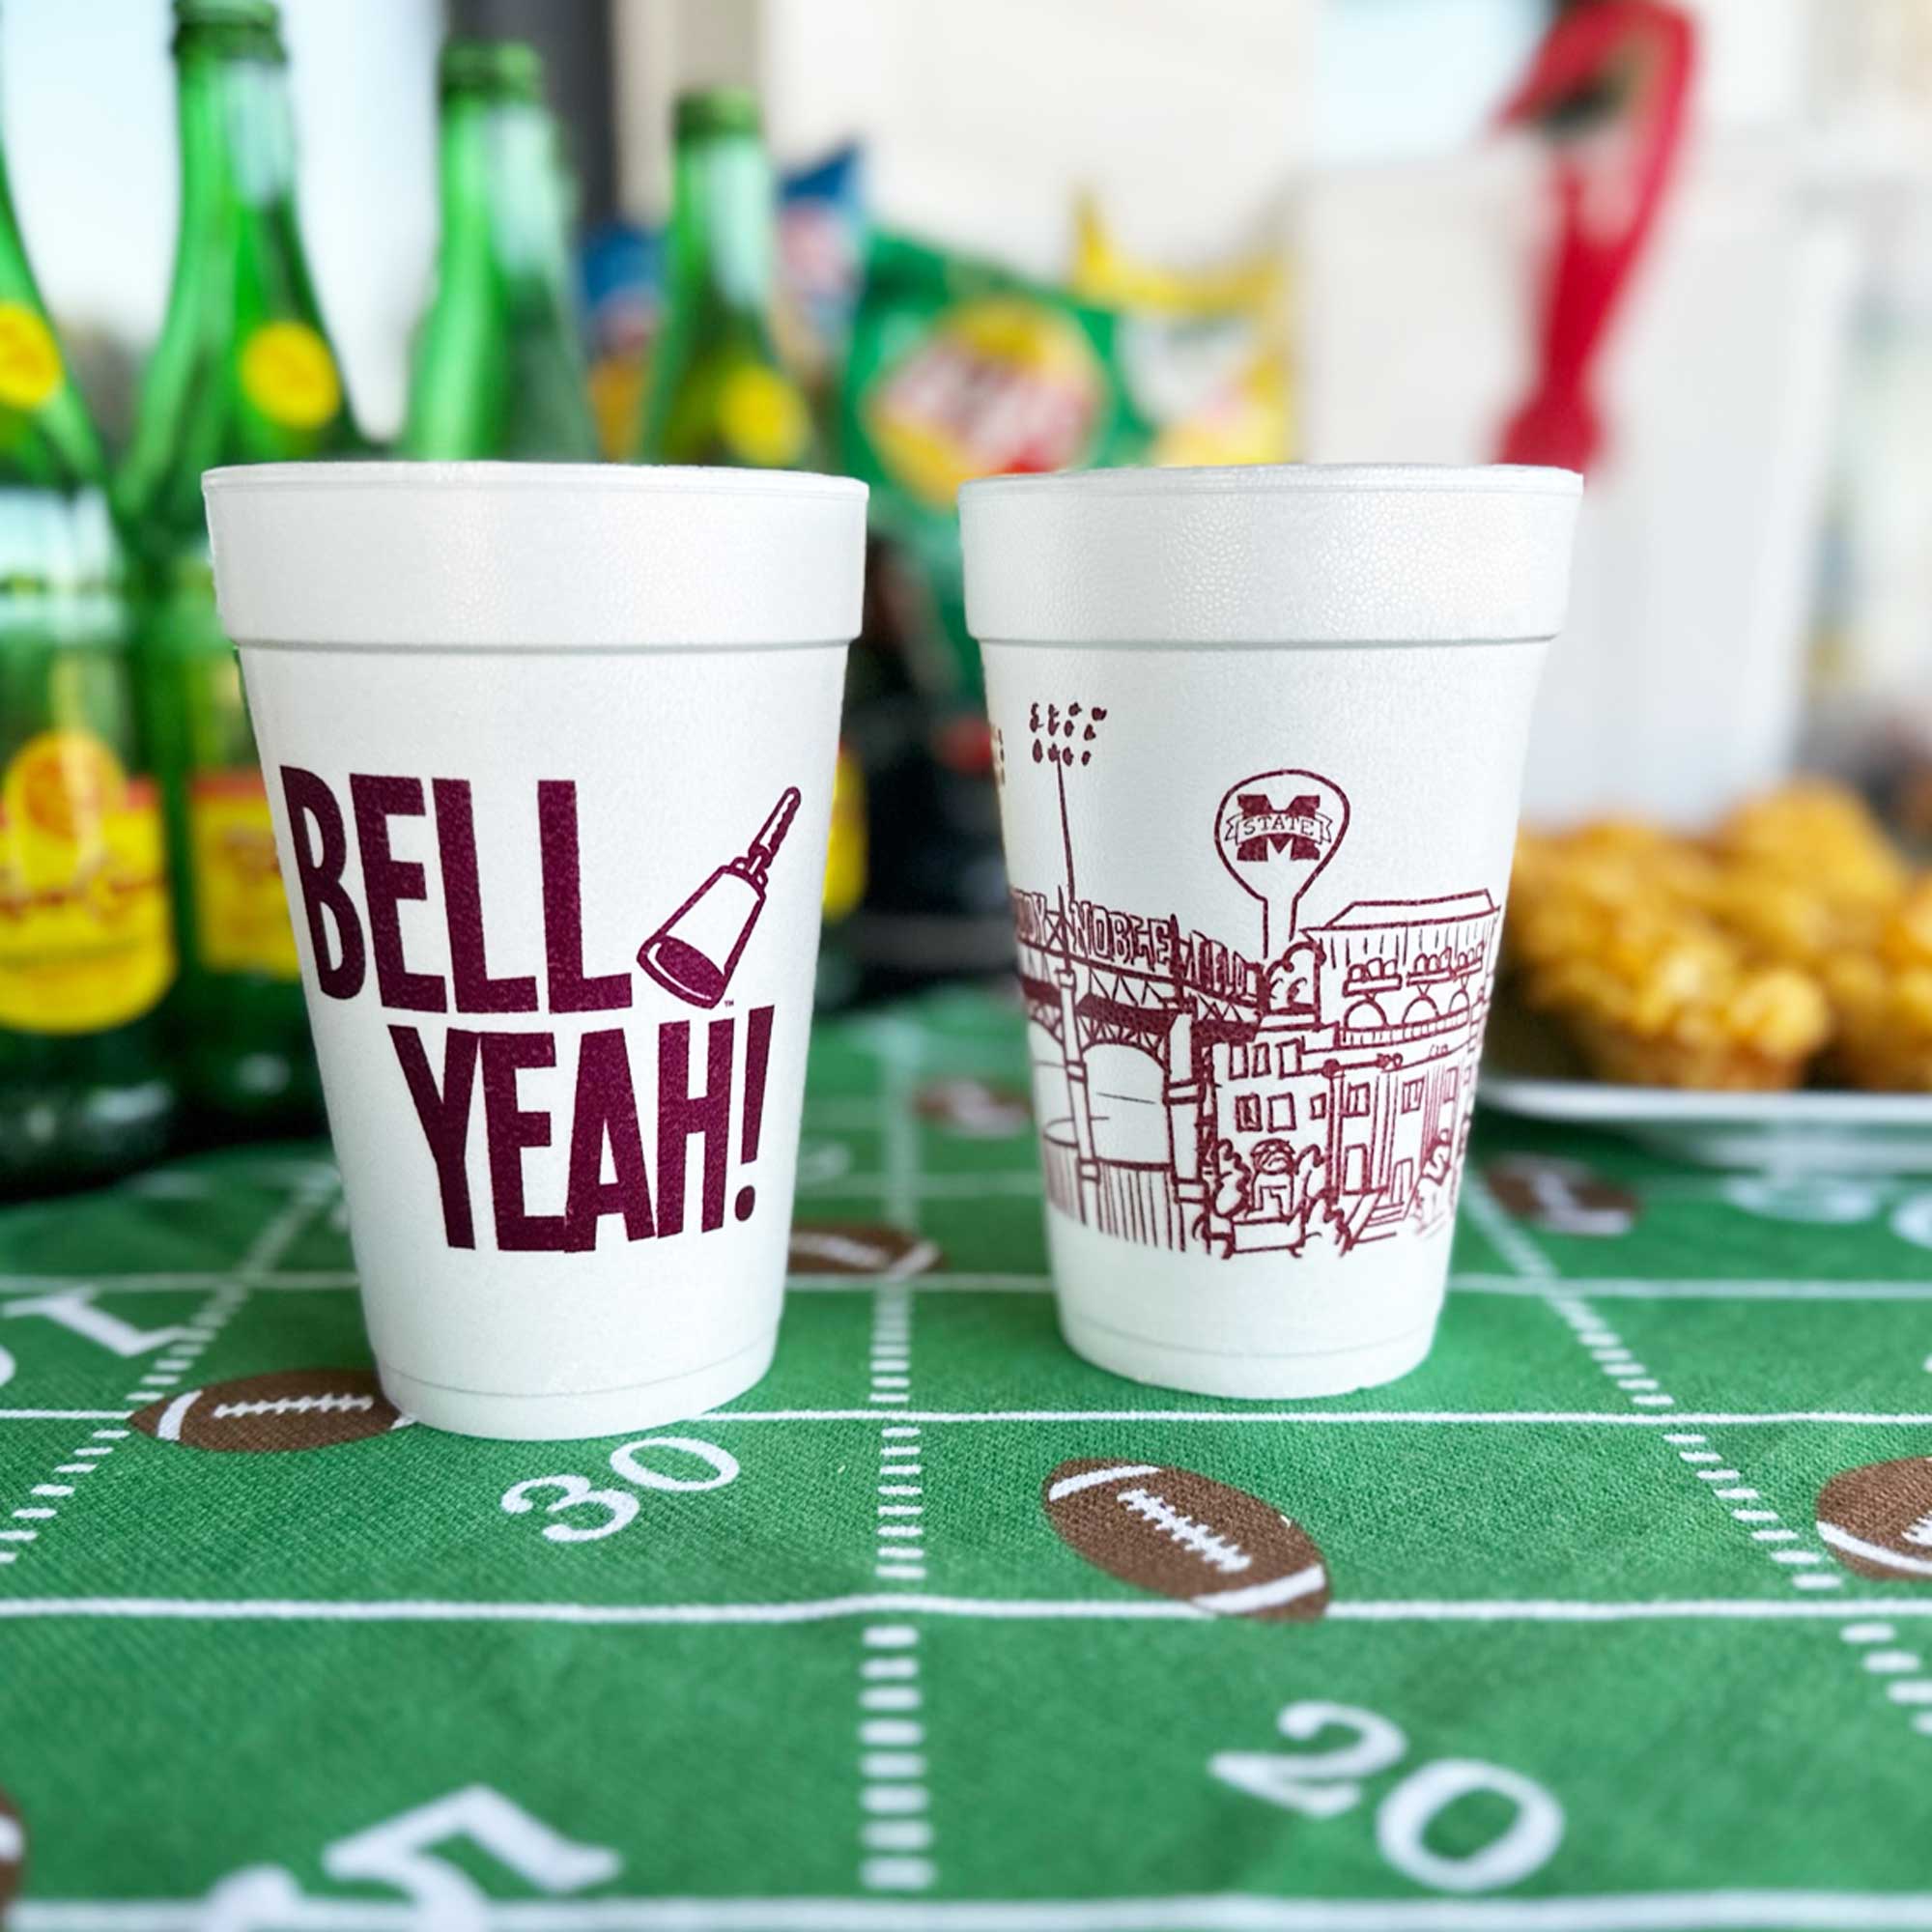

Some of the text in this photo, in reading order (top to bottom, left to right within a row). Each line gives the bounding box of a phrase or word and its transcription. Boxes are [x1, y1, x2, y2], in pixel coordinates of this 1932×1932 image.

[1236, 794, 1321, 862] M
[1242, 815, 1315, 838] STATE
[280, 765, 633, 1013] BELL
[1068, 900, 1173, 971] NOBLE
[387, 1005, 775, 1253] YEAH!
[501, 1435, 740, 1544] 30
[1208, 1700, 1565, 1893] 20
